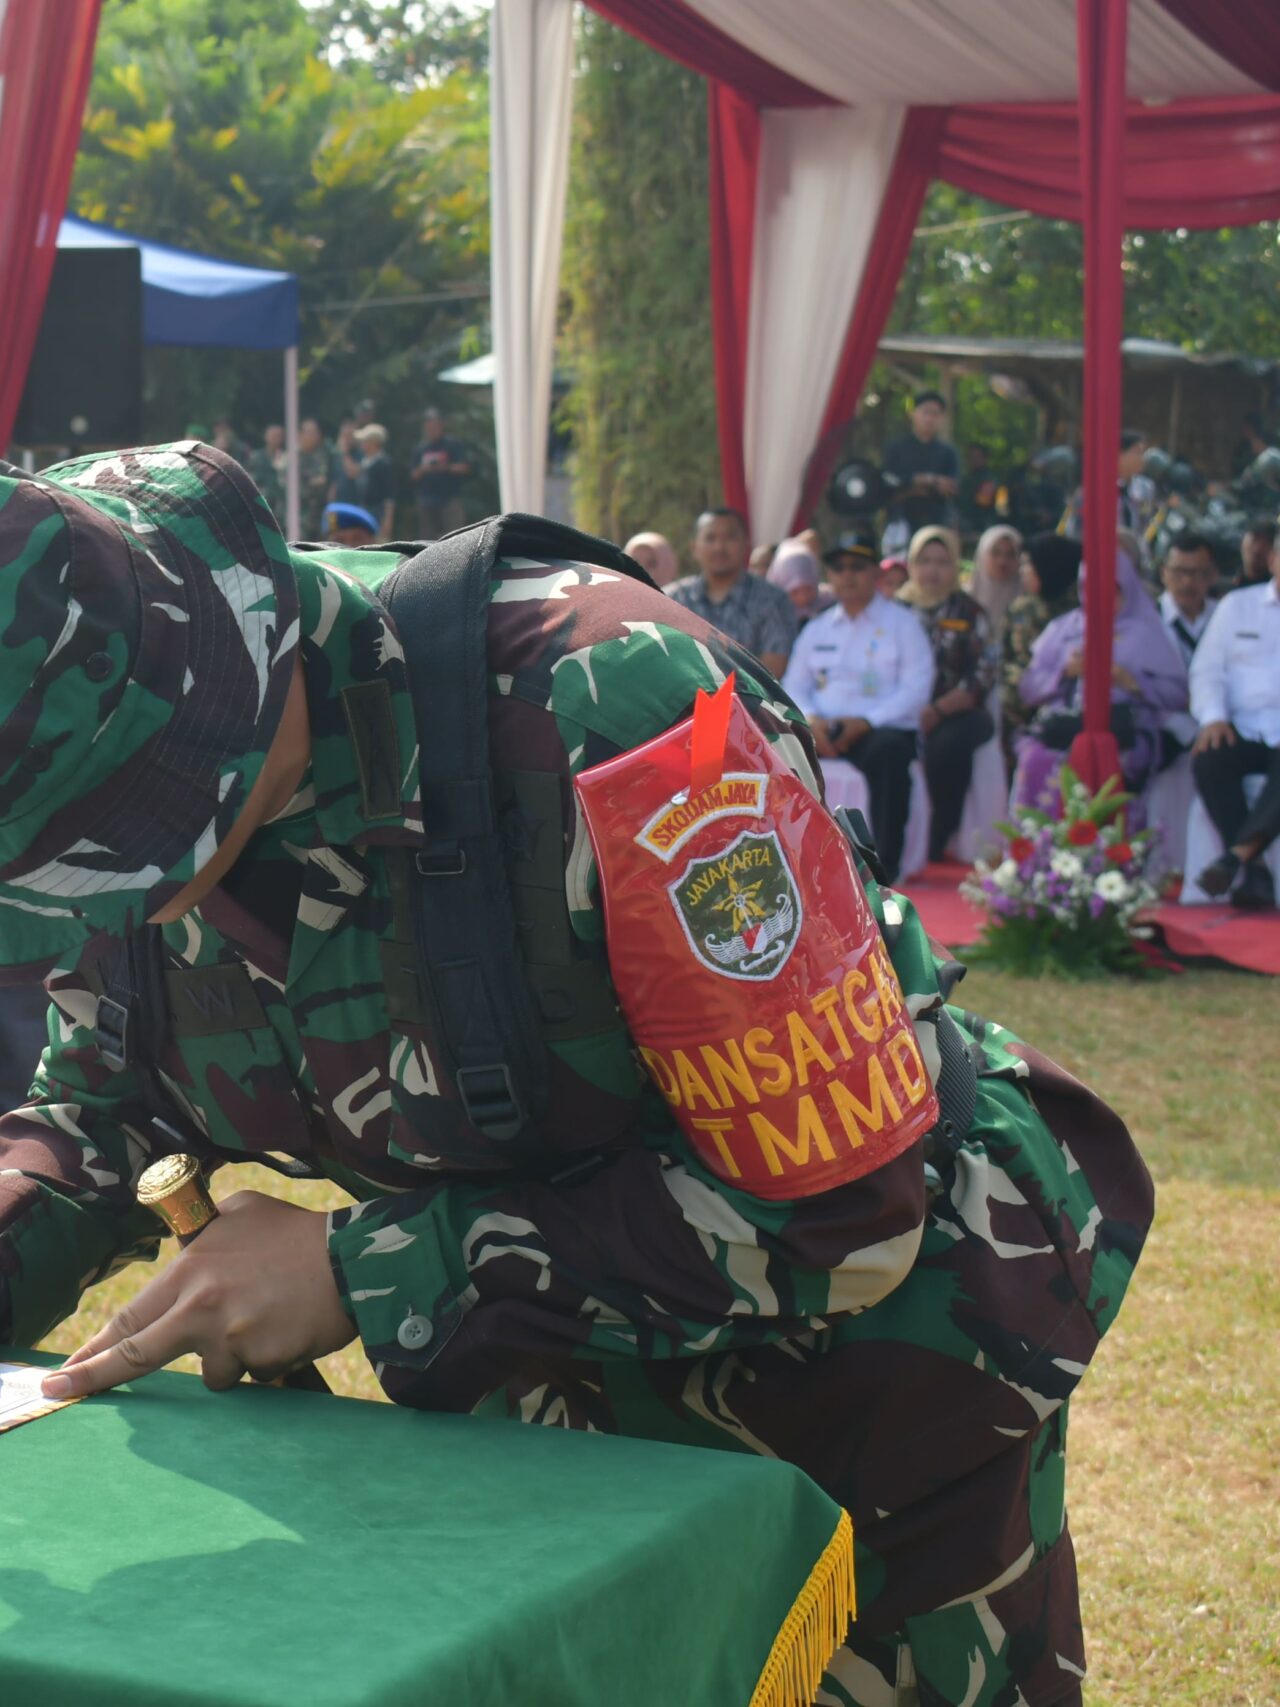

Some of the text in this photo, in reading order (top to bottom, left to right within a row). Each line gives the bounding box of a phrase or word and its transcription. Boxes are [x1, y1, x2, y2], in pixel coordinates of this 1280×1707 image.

[652, 783, 757, 847] SKODAM JAYA
[686, 846, 773, 906] JAYAKARTA
[638, 937, 905, 1111] DANSATGA
[691, 1029, 927, 1178] TMMD
